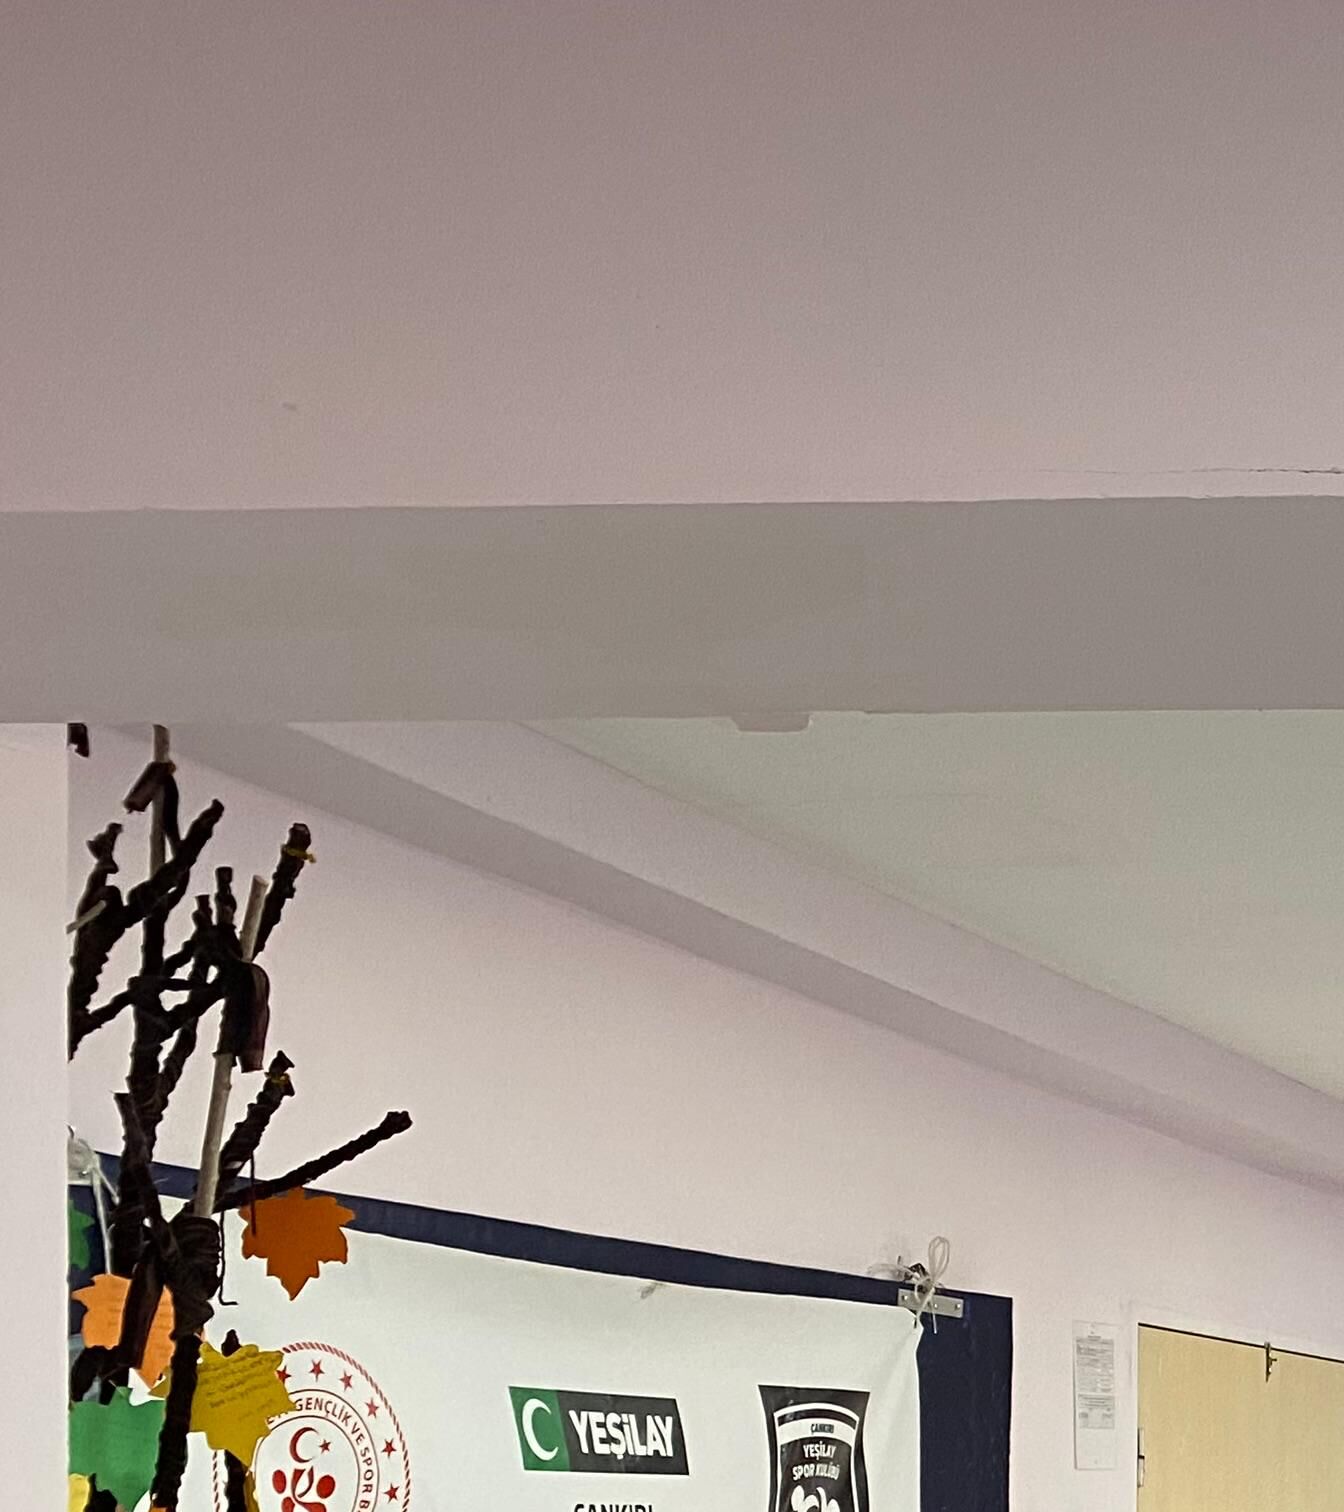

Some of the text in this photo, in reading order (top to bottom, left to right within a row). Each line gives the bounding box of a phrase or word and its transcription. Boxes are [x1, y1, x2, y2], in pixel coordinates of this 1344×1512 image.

[569, 1410, 673, 1460] YEŞİLAY
[803, 1441, 837, 1460] YEŞİLAY
[351, 1422, 365, 1446] VE
[360, 1447, 374, 1493] SPOR
[792, 1464, 815, 1481] SPOR
